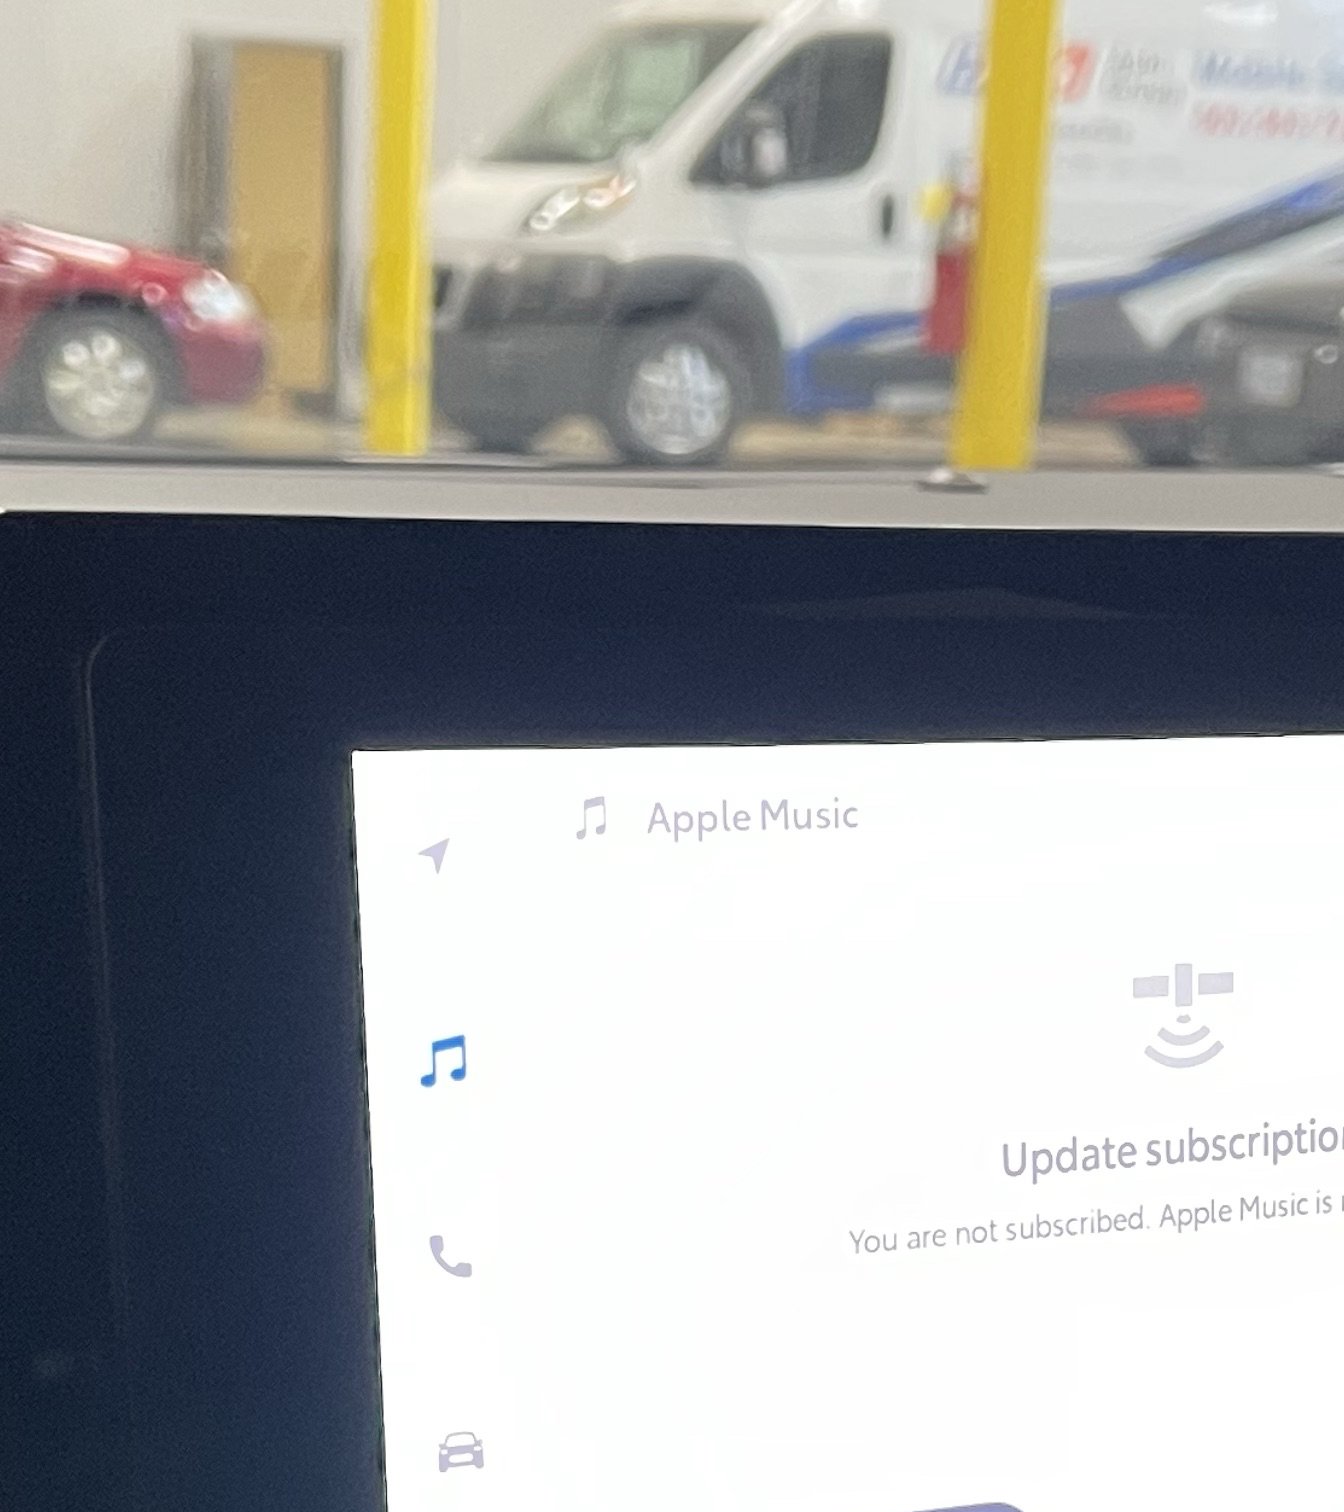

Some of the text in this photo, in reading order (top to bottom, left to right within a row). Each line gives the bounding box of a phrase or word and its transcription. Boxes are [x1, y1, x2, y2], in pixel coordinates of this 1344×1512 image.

[647, 796, 859, 843] Apple Music
[1002, 1135, 1138, 1185] Update
[849, 1228, 898, 1255] You
[906, 1227, 947, 1250] are
[955, 1219, 999, 1246] not
[1005, 1204, 1152, 1241] subscribed.
[1159, 1199, 1233, 1234] Apple
[1239, 1192, 1309, 1222] Music
[1315, 1189, 1333, 1214] is
